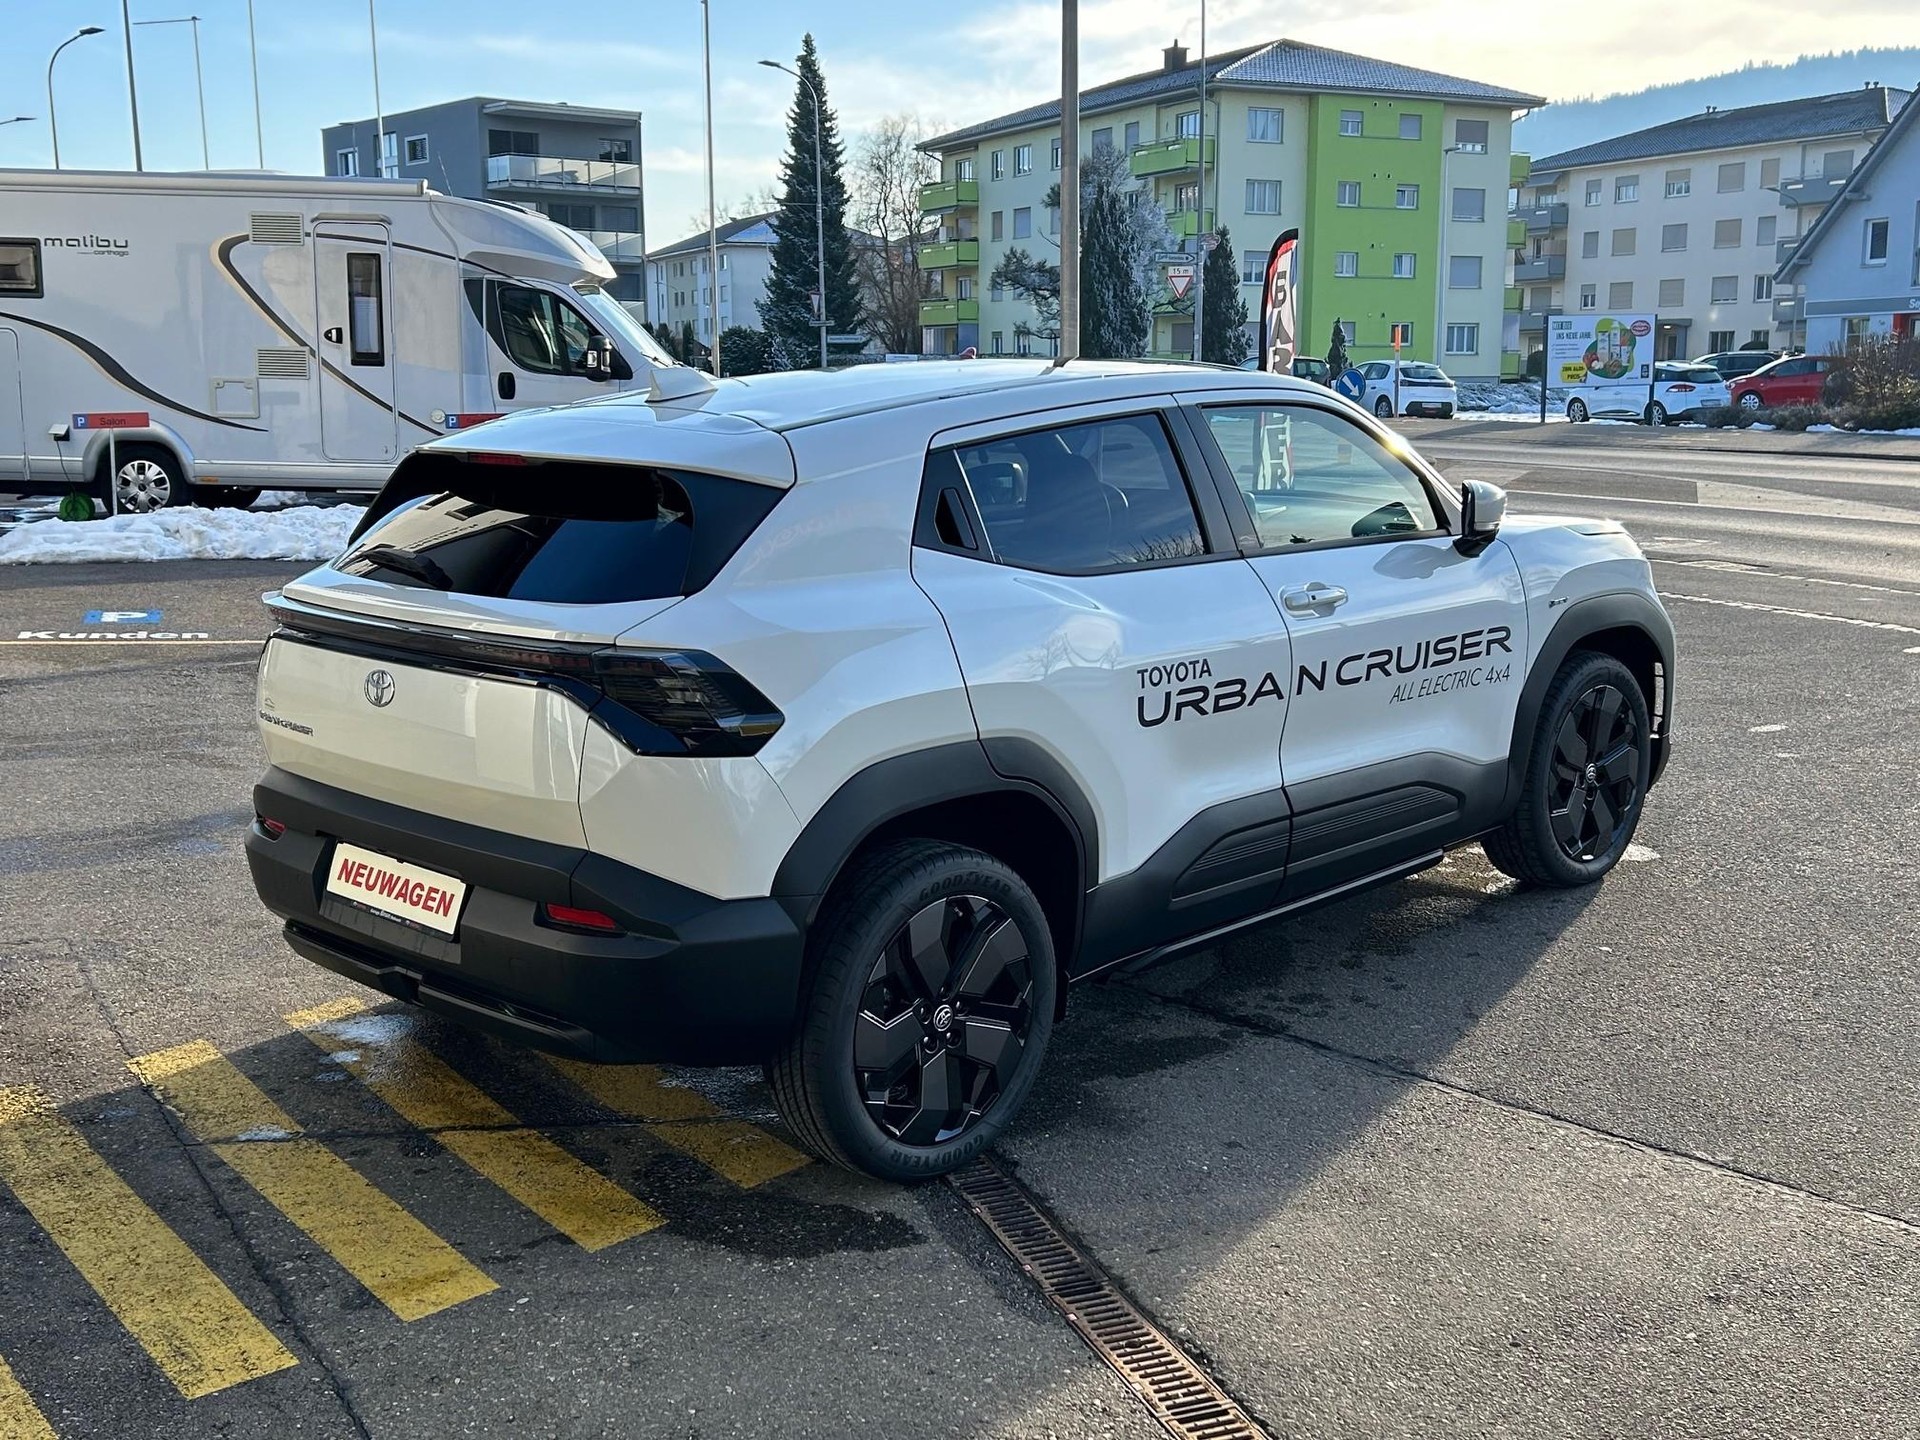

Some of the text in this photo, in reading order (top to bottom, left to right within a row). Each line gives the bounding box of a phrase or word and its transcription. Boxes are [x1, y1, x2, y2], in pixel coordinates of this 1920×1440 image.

[44, 235, 128, 248] malibu
[1172, 267, 1181, 275] 15
[77, 417, 85, 427] P
[99, 417, 127, 426] Salon
[448, 416, 457, 427] P
[17, 631, 209, 639] Kunden
[1136, 657, 1212, 690] TOYOTA
[1137, 625, 1513, 728] URBAN CRUISER
[1389, 663, 1511, 704] ALL ELECTRIC 4x4
[337, 858, 455, 917] NEUWAGEN
[918, 871, 1013, 903] GOODYEAR
